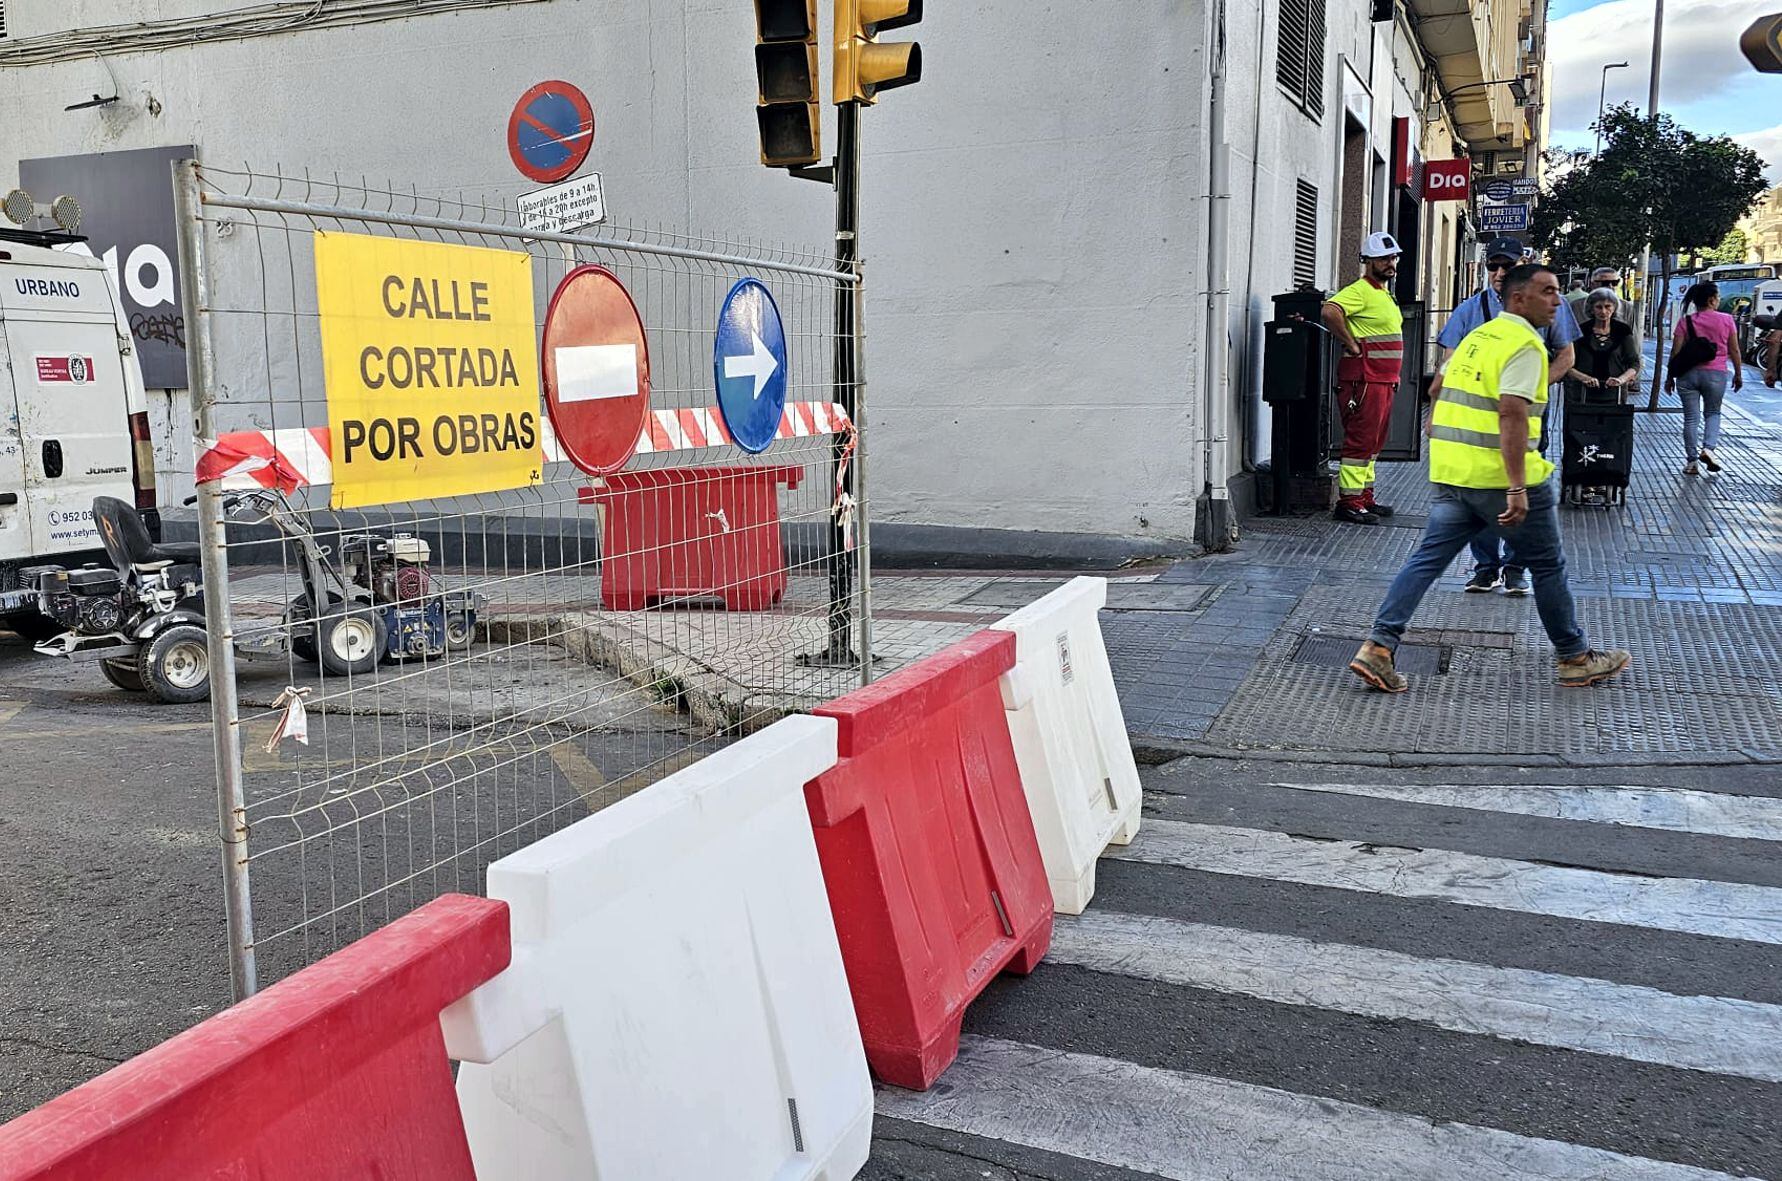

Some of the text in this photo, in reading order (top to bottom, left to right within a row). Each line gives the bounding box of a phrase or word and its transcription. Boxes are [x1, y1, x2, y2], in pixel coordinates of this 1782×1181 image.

[559, 192, 568, 201] de
[569, 188, 574, 198] 9
[569, 195, 598, 209] excepto
[559, 209, 595, 225] descarga
[1487, 216, 1521, 224] JOVIER
[15, 278, 80, 298] URBANO
[382, 275, 491, 322] CALLE
[360, 346, 520, 390] CORTADA
[343, 411, 535, 464] POR OBRAS
[85, 466, 128, 475] JUMPER
[62, 510, 94, 522] 952 03
[51, 528, 100, 541] www.setym
